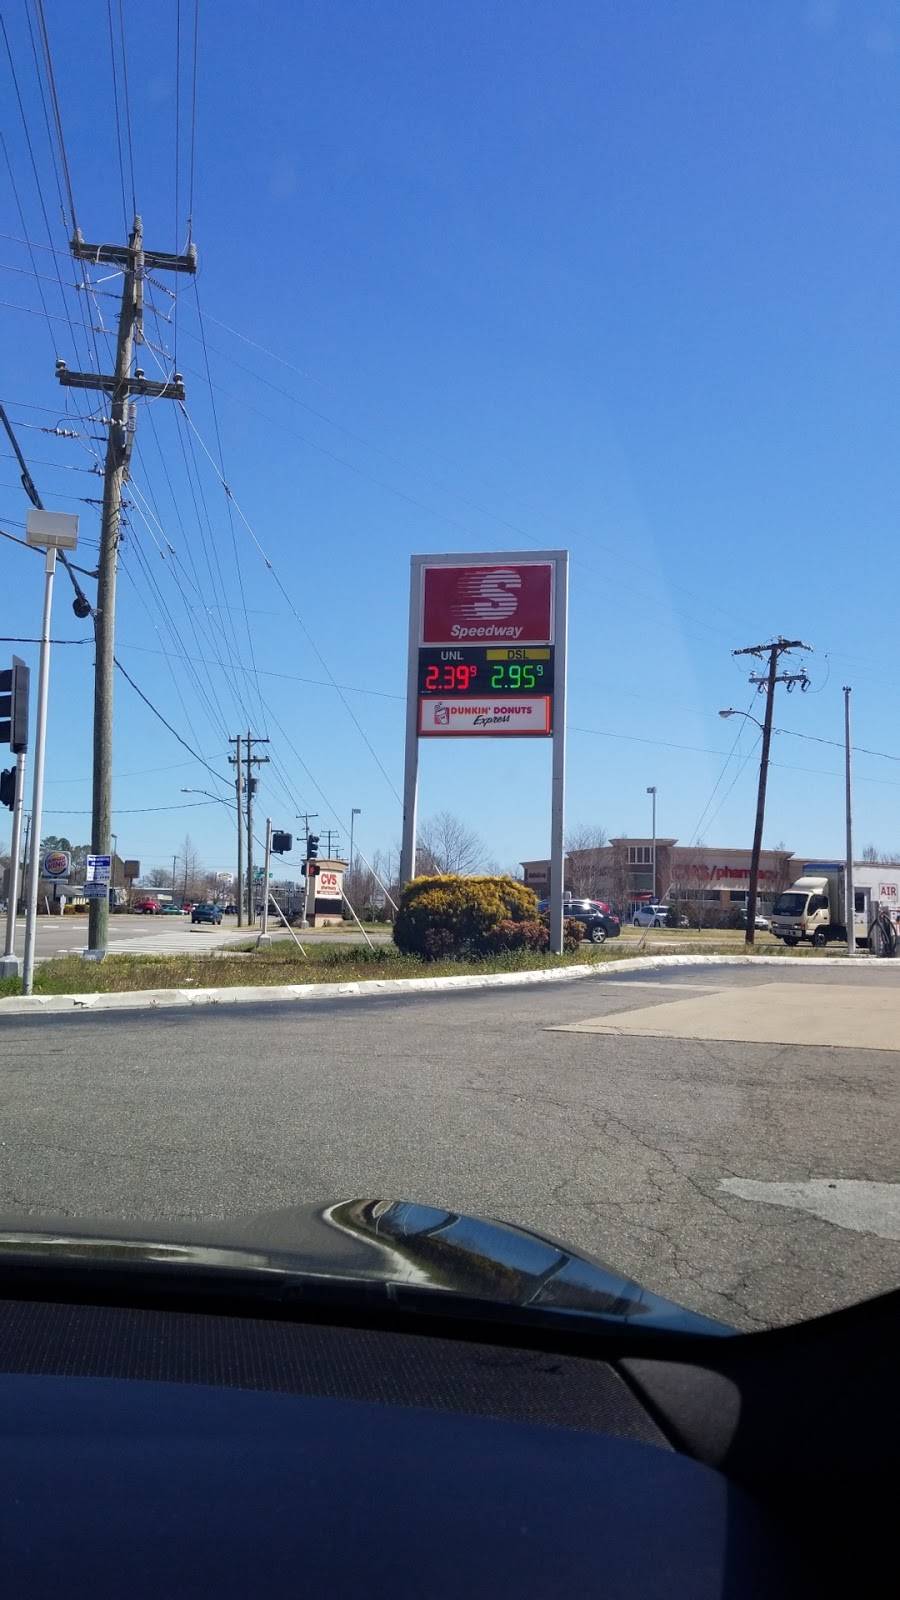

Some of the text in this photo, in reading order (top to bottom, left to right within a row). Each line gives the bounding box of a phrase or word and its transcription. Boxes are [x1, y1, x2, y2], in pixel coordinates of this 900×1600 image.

[450, 624, 524, 639] Speedway
[440, 650, 528, 660] UNL DSL
[450, 706, 533, 715] DUNKIN' DONUTS
[473, 714, 510, 727] Express
[320, 873, 337, 885] CVS
[880, 886, 897, 896] AIR
